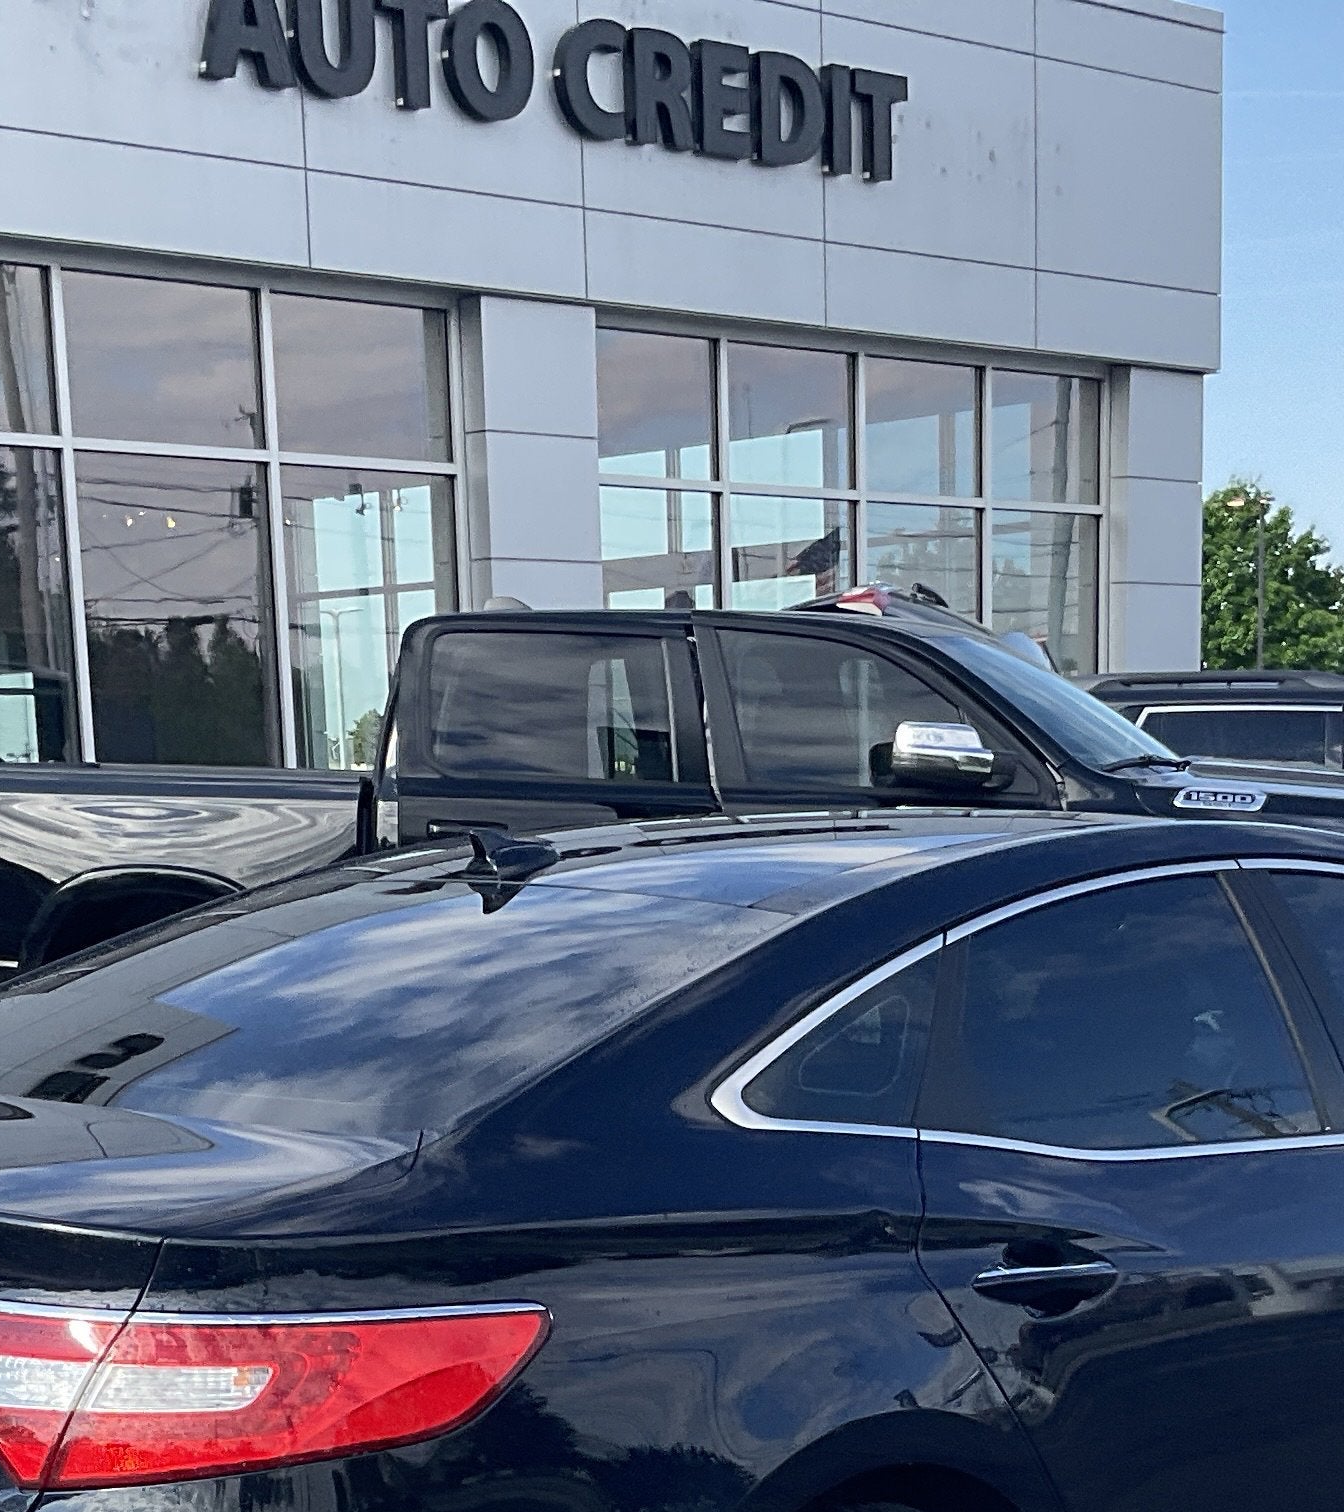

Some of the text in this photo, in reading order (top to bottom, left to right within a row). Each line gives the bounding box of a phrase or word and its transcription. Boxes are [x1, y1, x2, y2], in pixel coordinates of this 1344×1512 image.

[198, 0, 909, 182] AUTO CREDIT
[1188, 791, 1253, 804] 1500
